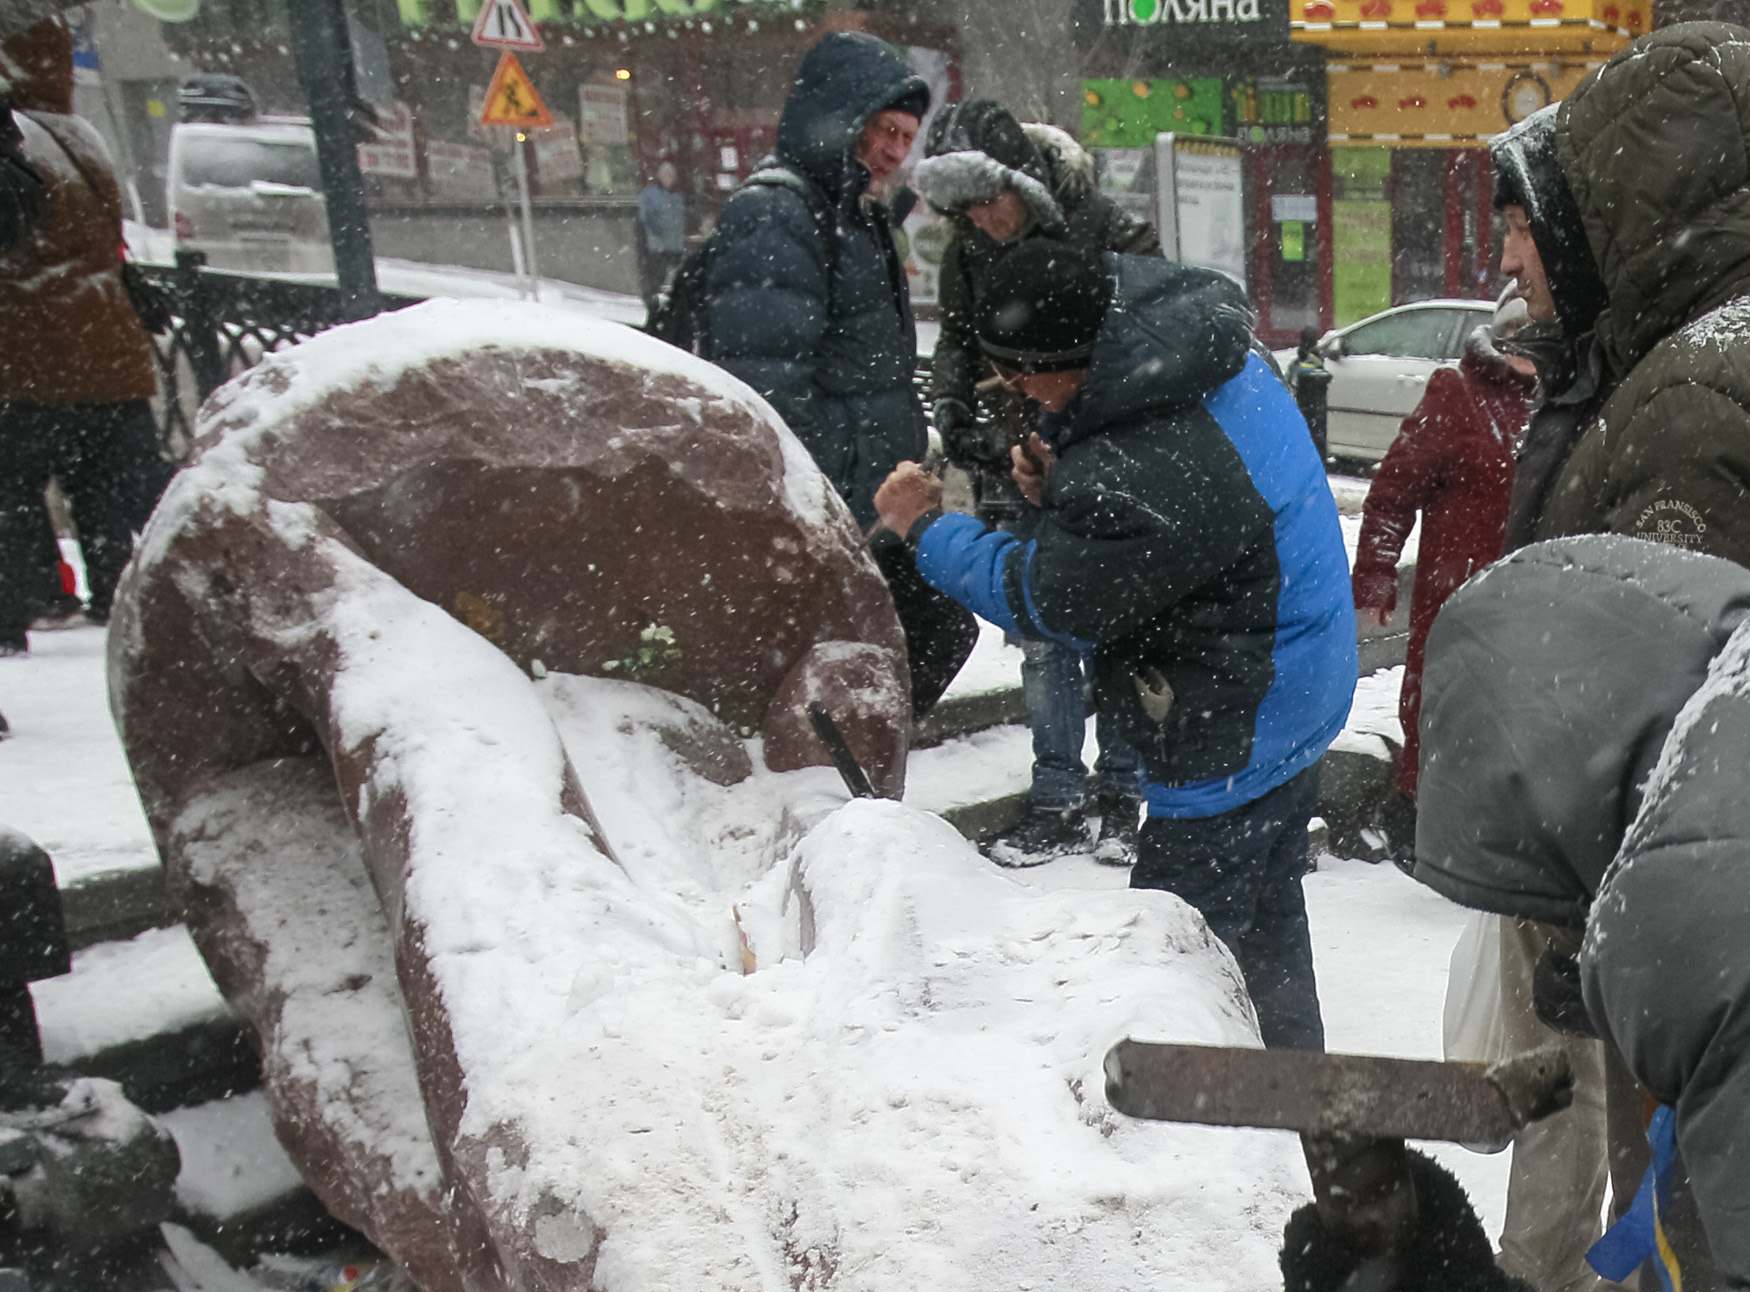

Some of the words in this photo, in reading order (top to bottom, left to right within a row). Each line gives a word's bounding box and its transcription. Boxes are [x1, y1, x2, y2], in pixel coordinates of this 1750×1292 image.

[1636, 505, 1654, 528] SAN
[1654, 500, 1706, 533] FRANSISCO
[1657, 519, 1682, 533] 83C
[1637, 531, 1703, 544] UNIVERSITY
